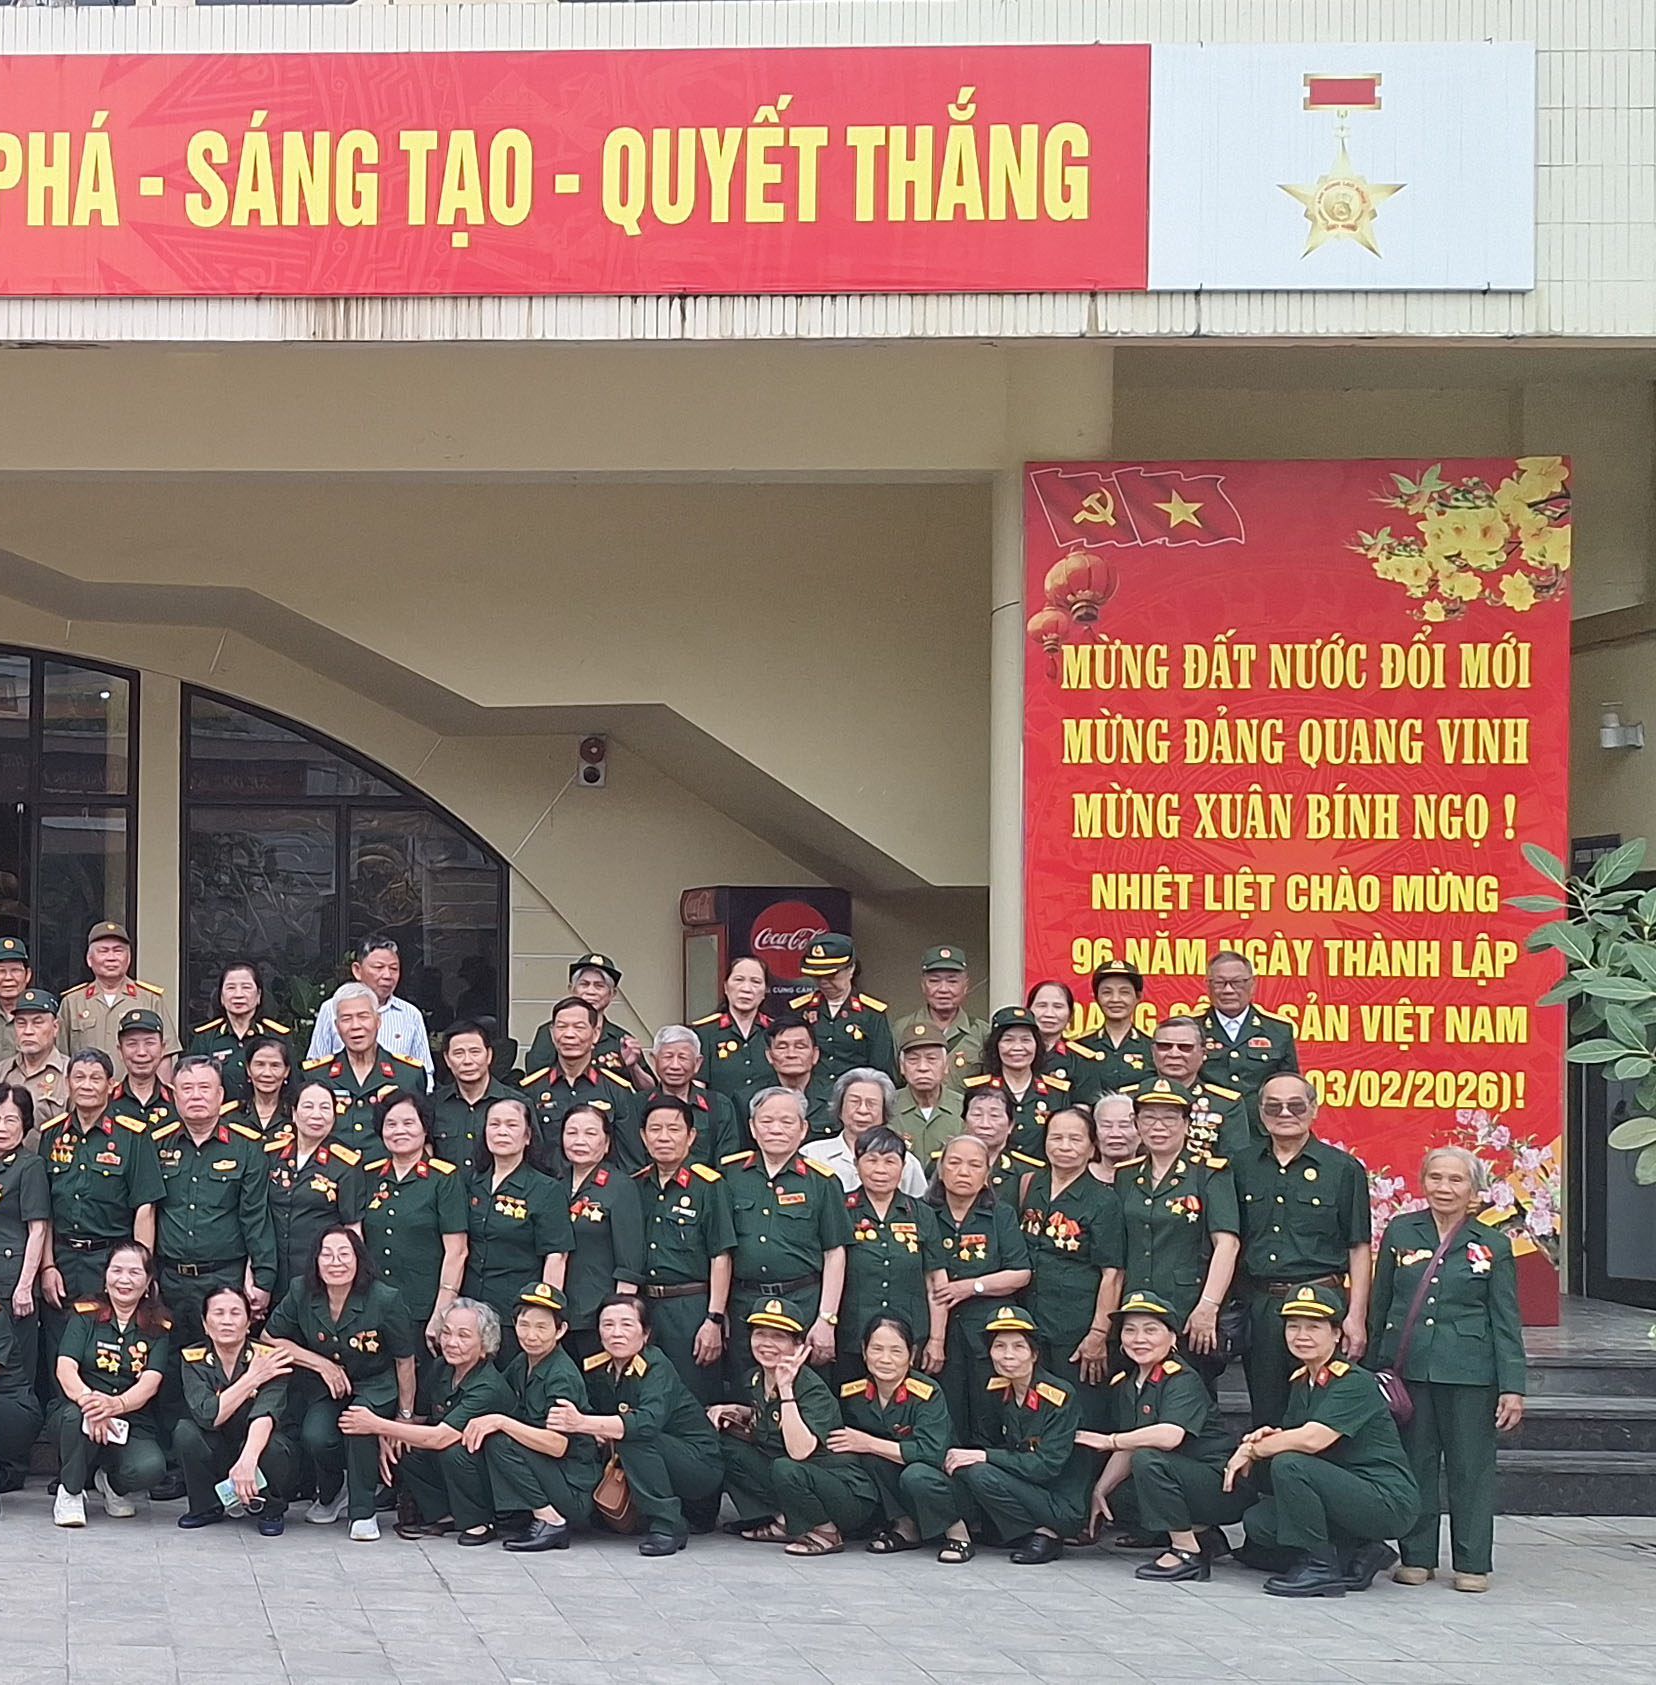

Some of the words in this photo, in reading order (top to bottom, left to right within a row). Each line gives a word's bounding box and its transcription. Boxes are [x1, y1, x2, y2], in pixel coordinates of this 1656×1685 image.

[140, 177, 163, 195] -
[186, 110, 378, 227] SÁNG
[400, 129, 532, 247] TẠO
[555, 175, 579, 193] -
[603, 95, 828, 235] QUYẾT
[847, 87, 1088, 221] THẮNG
[1061, 635, 1169, 689] MỪNG
[1184, 629, 1256, 688] ĐẤT
[1269, 633, 1366, 688] NƯỚC
[1381, 626, 1445, 688] ĐỔI
[1459, 632, 1530, 688] MỚI
[1063, 708, 1170, 763] MỪNG
[1184, 706, 1285, 764] ĐẢNG
[1299, 719, 1424, 768] QUANG
[1437, 719, 1528, 763] VINH
[1073, 783, 1180, 838] MỪNG
[1194, 784, 1292, 838] XUÂN
[1307, 783, 1399, 839] BÍNH
[1413, 794, 1488, 847] NGỌ
[1505, 794, 1515, 839] !
[1092, 866, 1193, 918] NHIỆT
[1205, 867, 1275, 919] LIỆT
[1287, 867, 1379, 911] CHÀO
[1393, 868, 1498, 912] MỪNG
[1072, 938, 1114, 974] 96
[1126, 930, 1206, 975] NĂM
[1324, 928, 1441, 978] THÀNH
[1452, 930, 1518, 987] LẬP
[1277, 992, 1349, 1042] SẢN
[1361, 994, 1434, 1051] VIỆT
[1445, 1005, 1528, 1043] NAM
